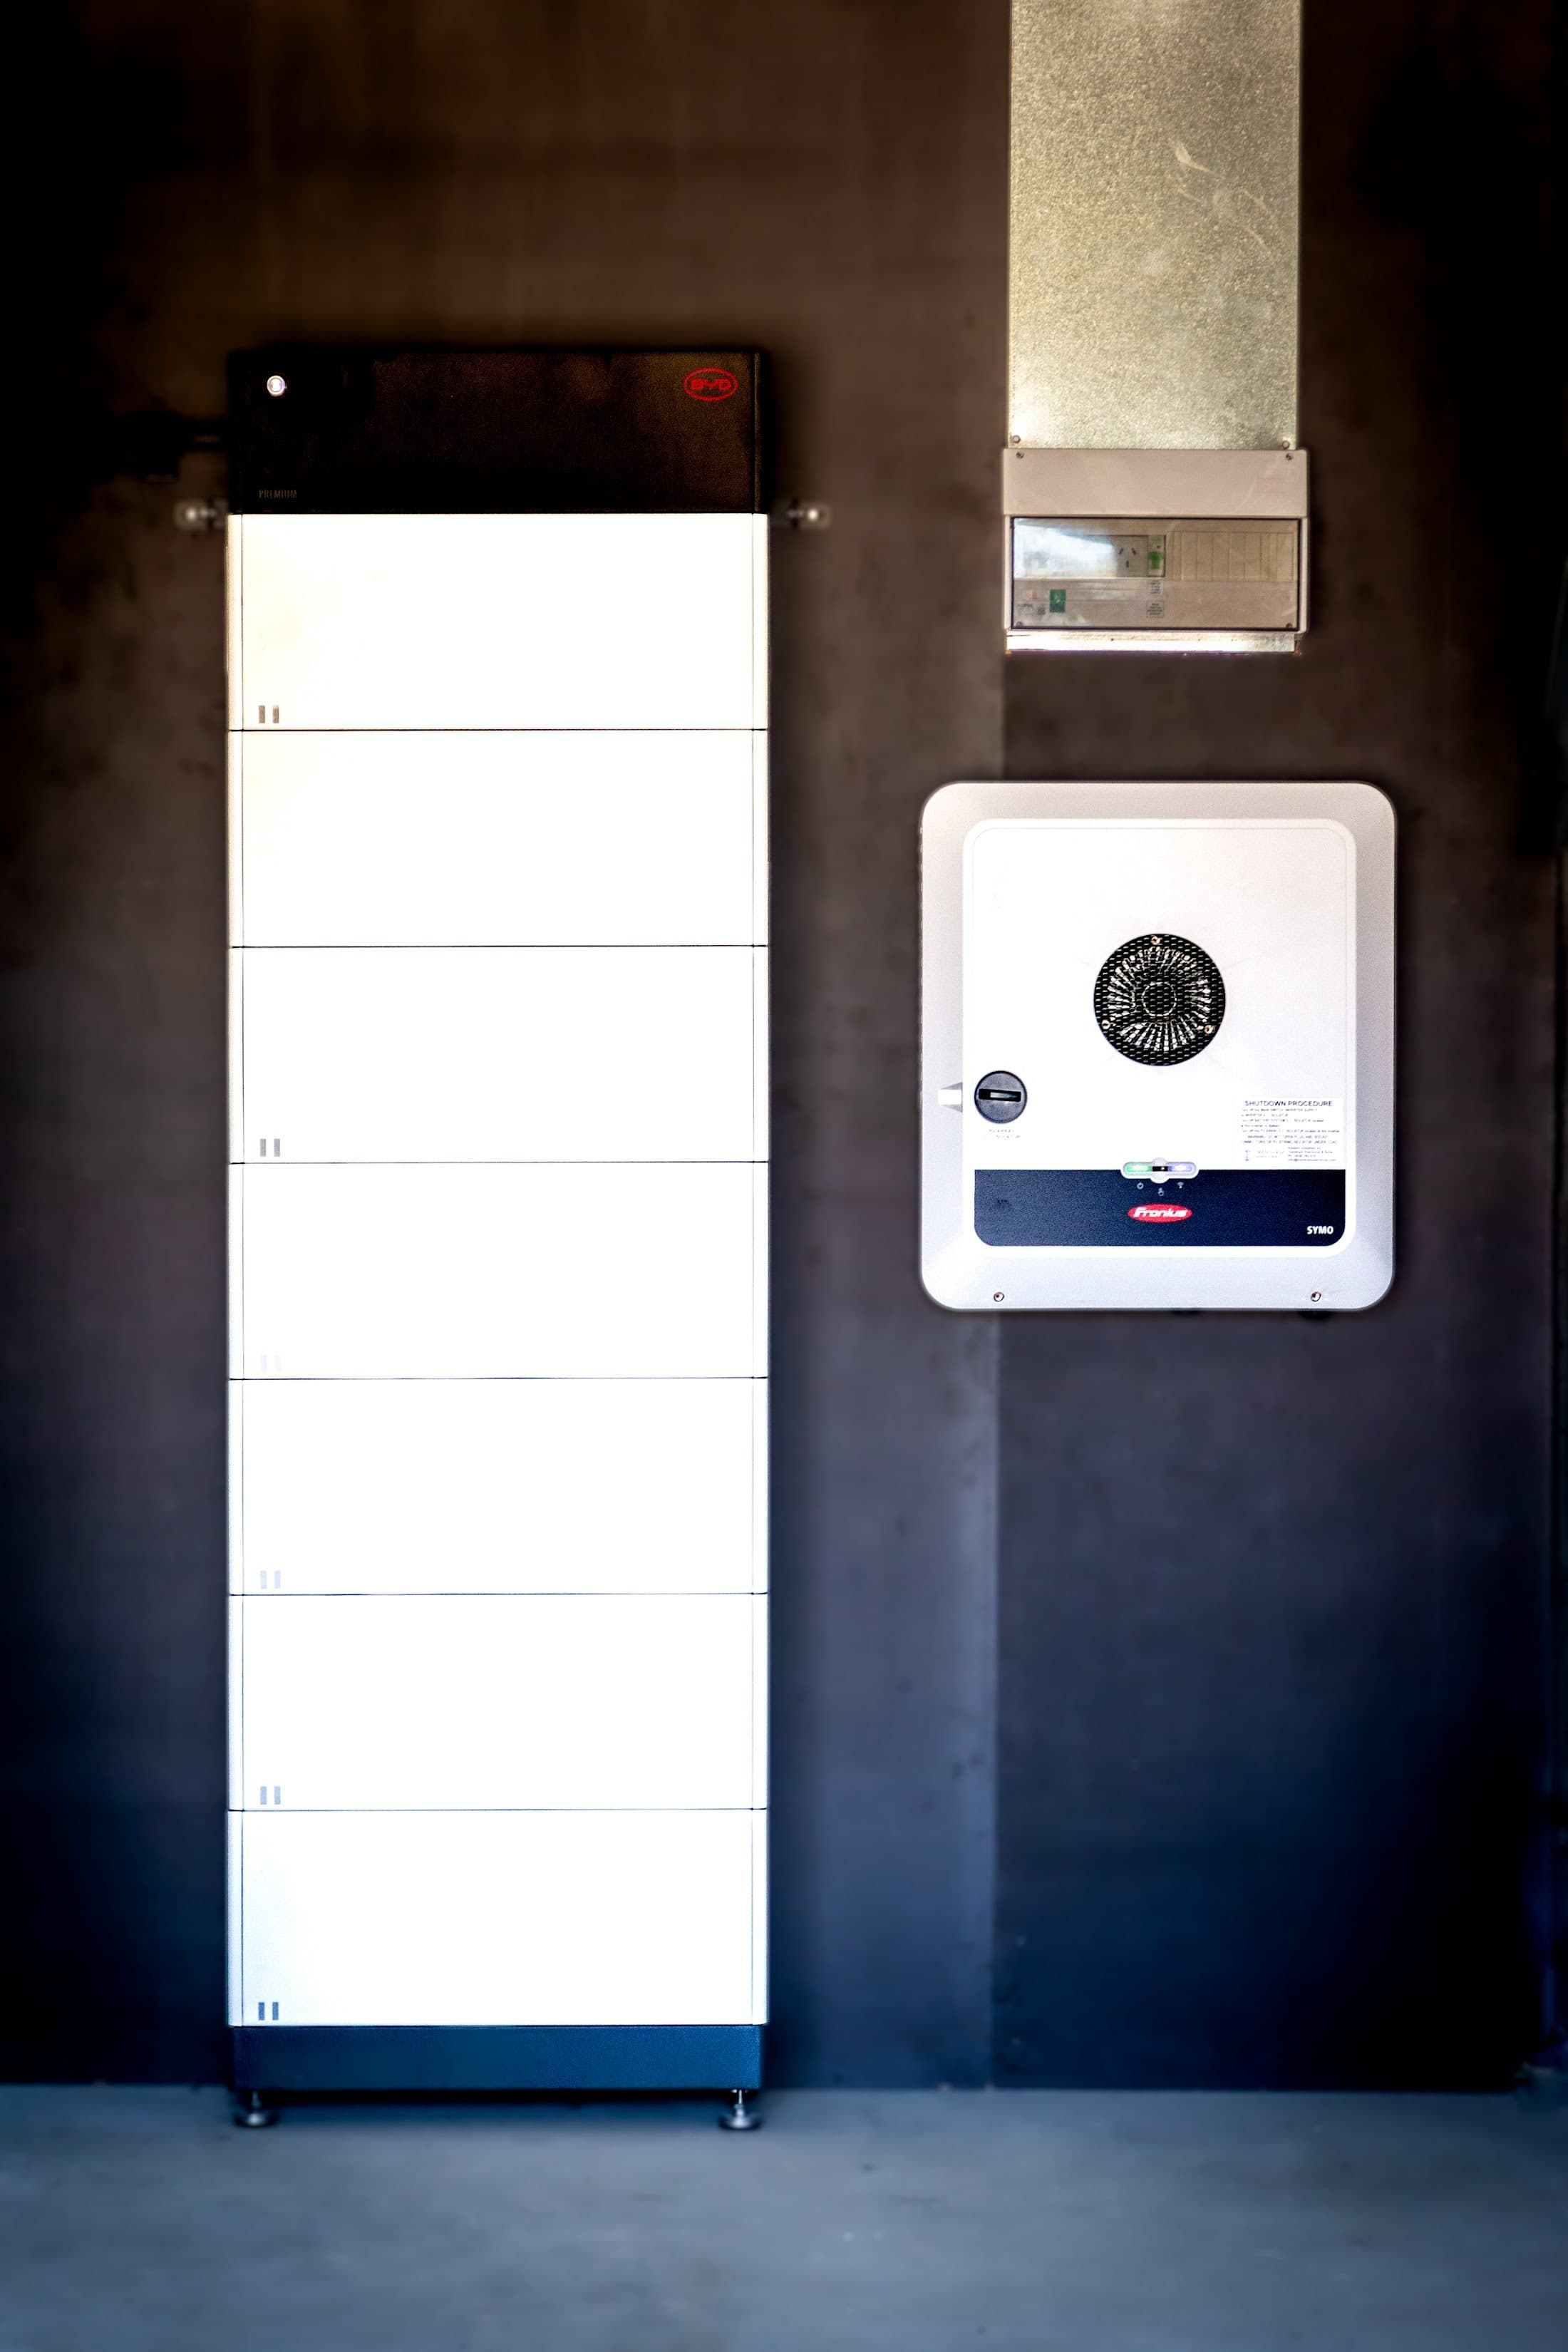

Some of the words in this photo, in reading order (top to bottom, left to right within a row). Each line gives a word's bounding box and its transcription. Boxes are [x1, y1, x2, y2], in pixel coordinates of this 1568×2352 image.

[690, 377, 731, 390] BYD
[259, 490, 297, 500] PREMIUM
[1133, 1206, 1187, 1218] Fronius
[1306, 1225, 1334, 1234] SYMO
